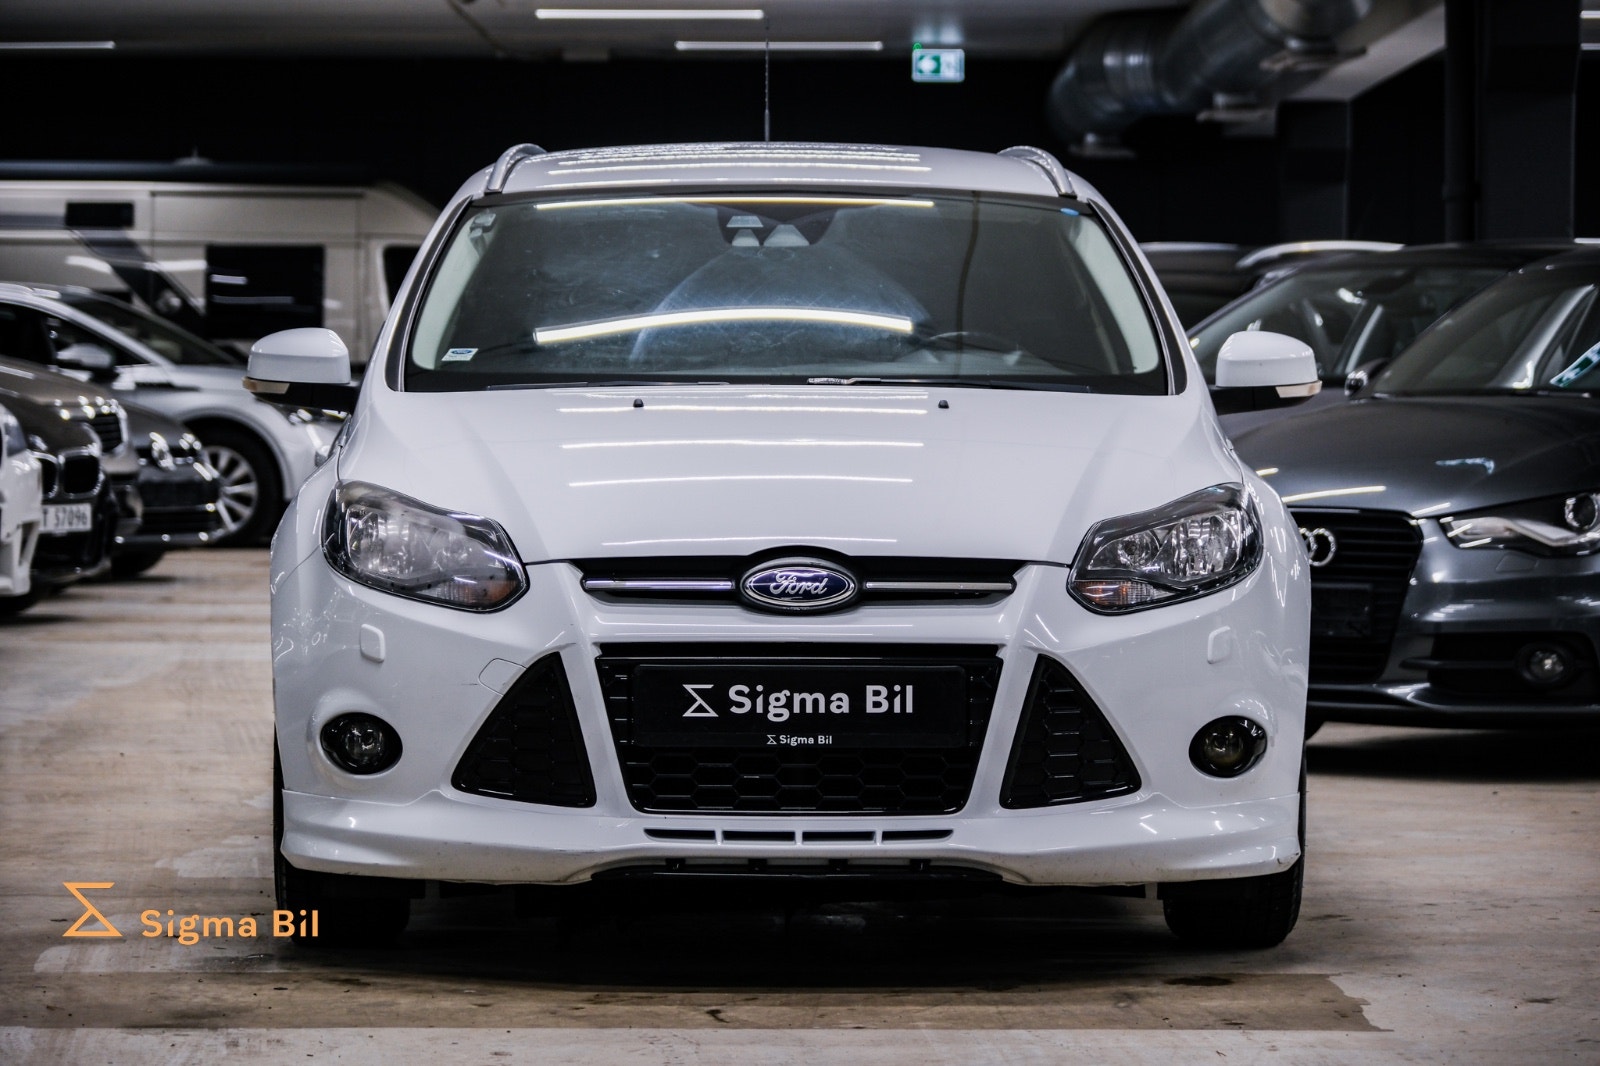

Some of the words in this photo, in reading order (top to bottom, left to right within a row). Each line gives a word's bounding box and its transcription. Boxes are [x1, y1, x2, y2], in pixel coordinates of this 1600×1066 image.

[769, 573, 829, 595] Ford
[728, 684, 850, 722] Sigma
[865, 684, 913, 714] Bil
[779, 734, 815, 747] Sigma
[817, 735, 833, 745] Bil
